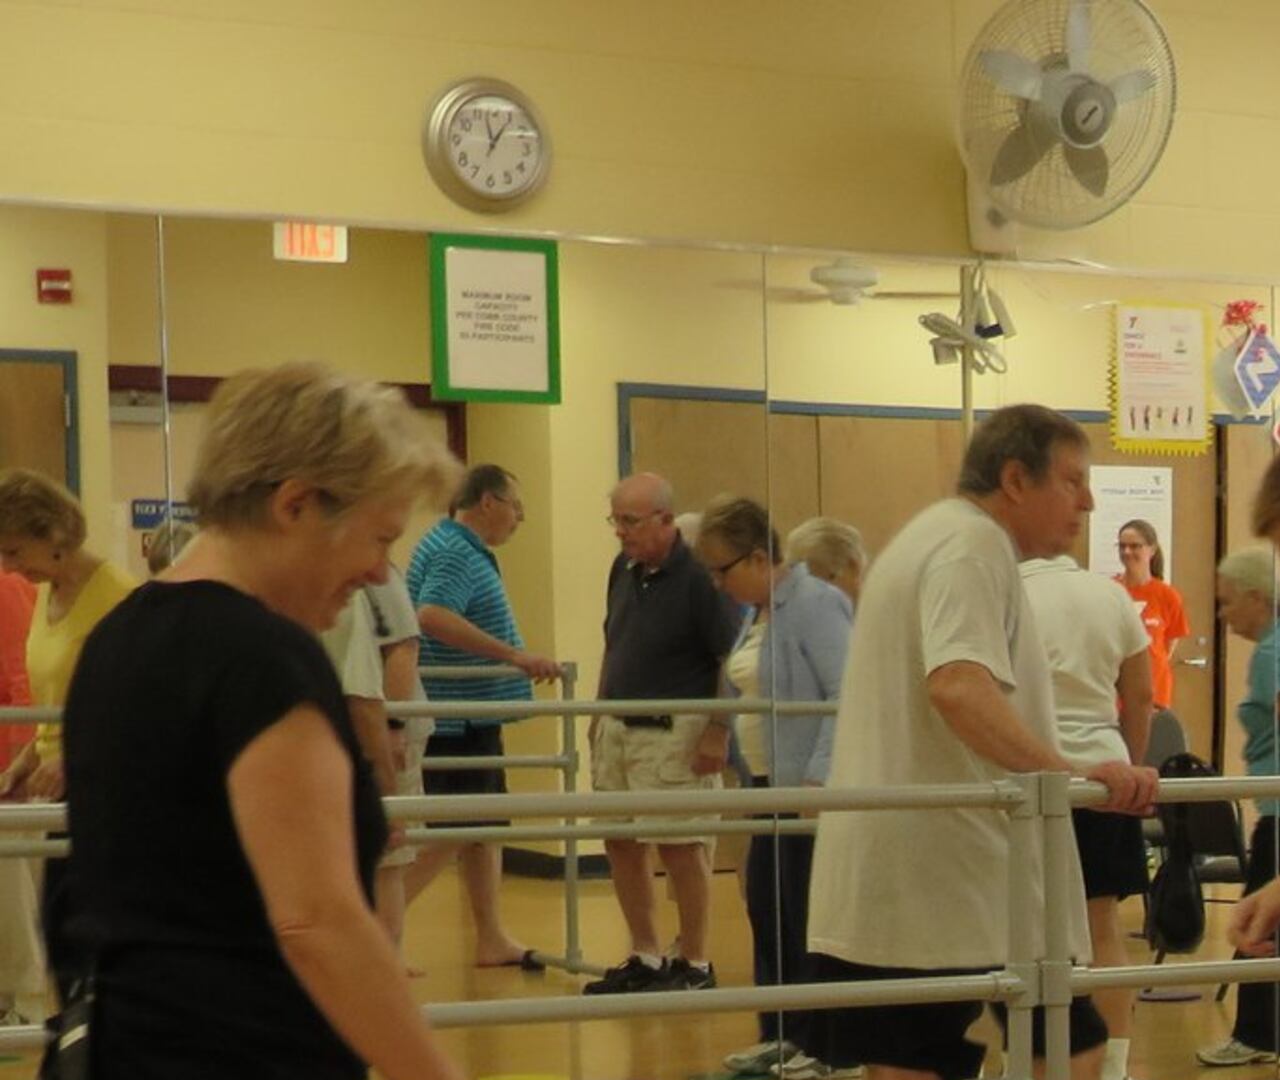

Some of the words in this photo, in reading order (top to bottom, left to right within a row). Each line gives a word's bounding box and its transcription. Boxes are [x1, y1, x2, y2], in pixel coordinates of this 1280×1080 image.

[457, 151, 469, 167] 8
[470, 165, 481, 179] 7
[485, 173, 496, 188] 6
